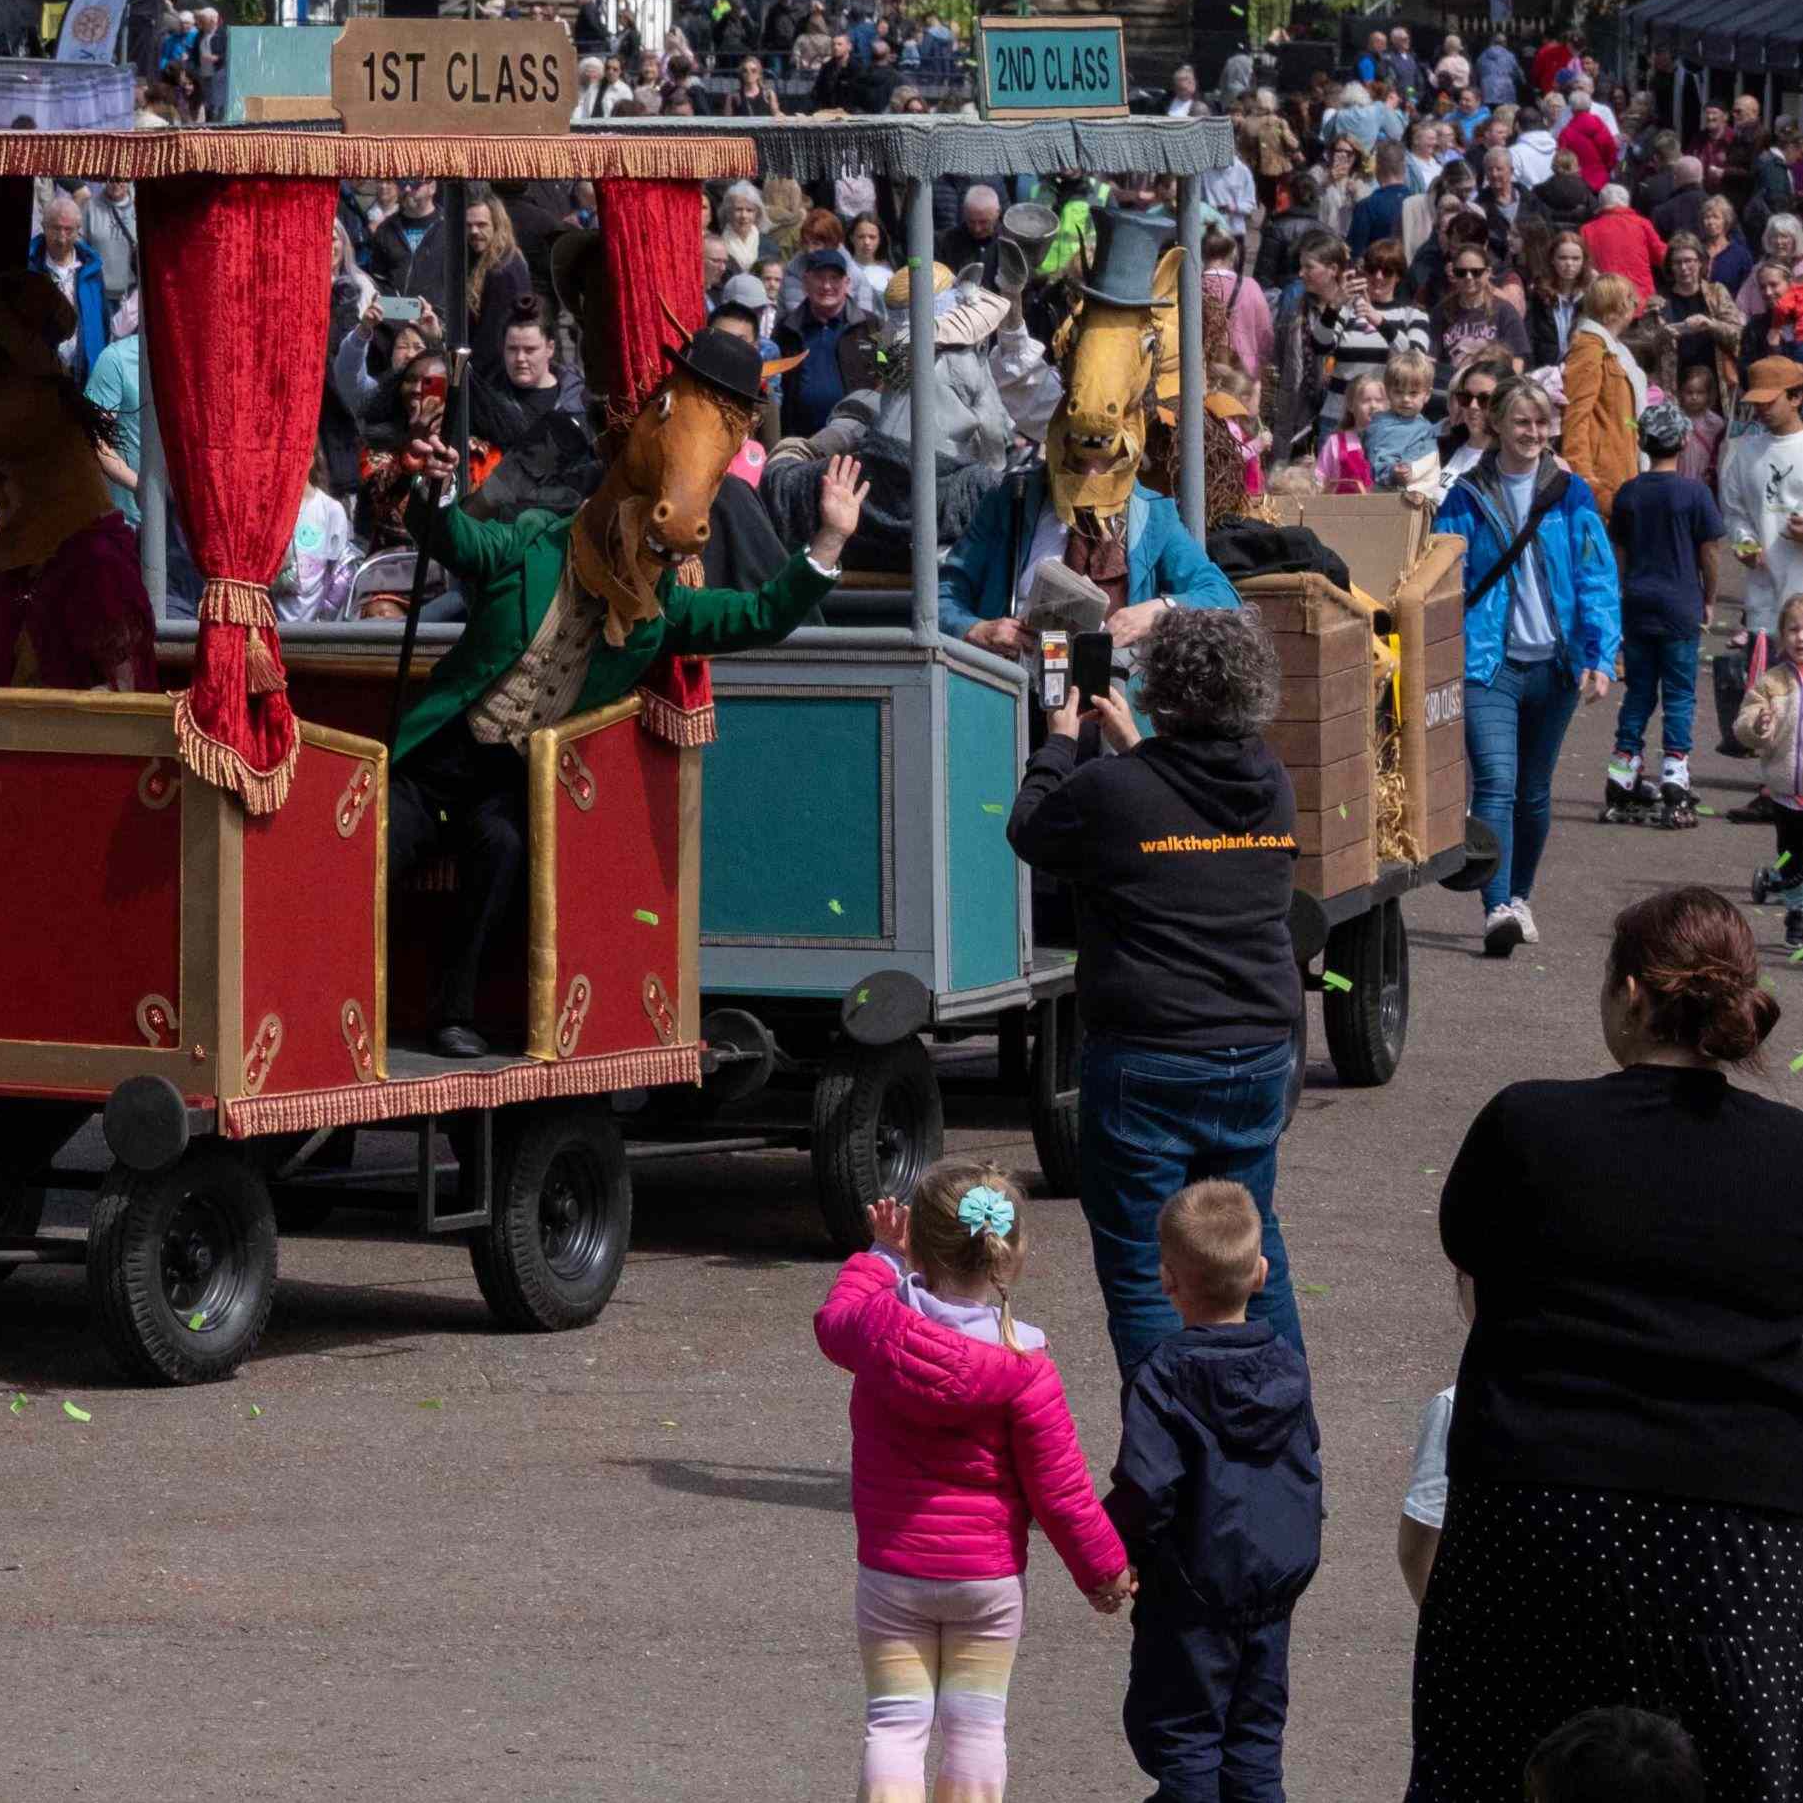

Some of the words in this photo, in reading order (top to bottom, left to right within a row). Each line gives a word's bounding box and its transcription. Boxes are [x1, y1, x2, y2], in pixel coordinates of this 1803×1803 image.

[362, 51, 426, 102] 1ST
[446, 51, 560, 103] CLASS
[996, 46, 1036, 91] 2ND
[1044, 46, 1110, 91] CLASS
[1140, 833, 1297, 853] walktheplank.co.uk
